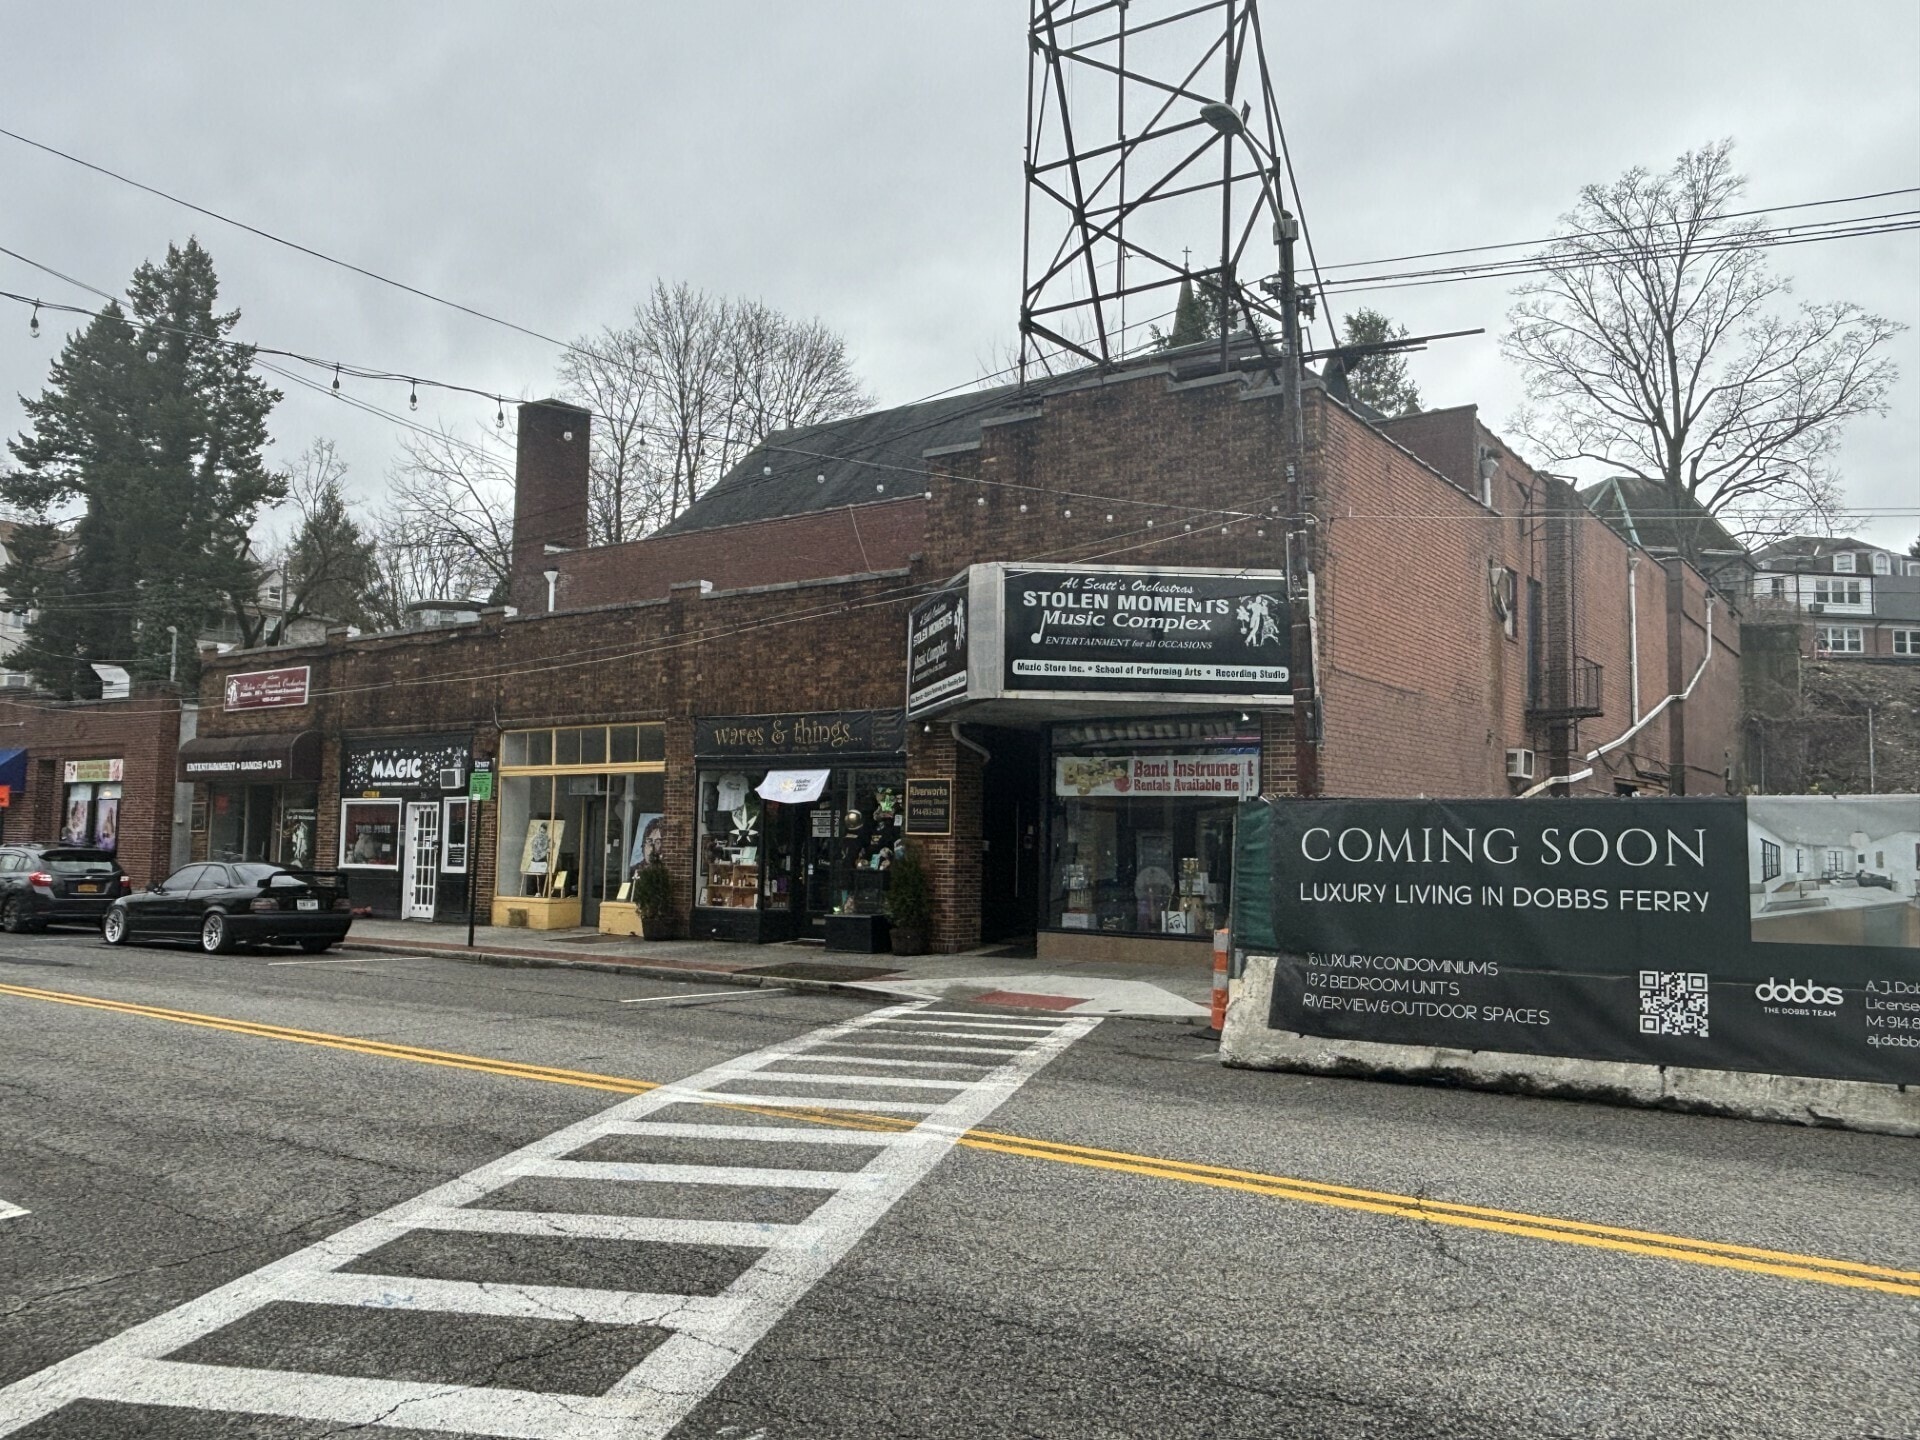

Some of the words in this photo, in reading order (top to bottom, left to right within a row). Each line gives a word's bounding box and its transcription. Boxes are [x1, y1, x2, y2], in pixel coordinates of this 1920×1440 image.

[1060, 577, 1079, 590] Al
[1082, 578, 1126, 591] Scatt's
[1132, 580, 1194, 593] Orchestras
[1023, 591, 1108, 609] STOLEN
[1118, 595, 1229, 614] MOMENTS
[1043, 610, 1105, 626] Music
[1113, 613, 1212, 632] Complex
[1045, 636, 1131, 647] ENTERTAINMENT
[1132, 639, 1144, 648] for
[1146, 639, 1156, 649] all
[1158, 639, 1213, 649] OCCASIONS
[1044, 663, 1066, 672] Store
[1069, 664, 1085, 673] Inc.
[1095, 664, 1123, 674] School
[1126, 665, 1134, 674] of
[1137, 666, 1182, 677] Performing
[1185, 667, 1202, 676] Arts
[1216, 668, 1257, 679] Recording
[1260, 669, 1286, 679] Studio
[715, 727, 764, 746] wares
[771, 719, 788, 745] &
[186, 762, 236, 772] ENTERTAINMENT
[240, 761, 262, 770] BANDS
[371, 758, 422, 779] MAGIC
[1134, 760, 1168, 777] Band
[1174, 759, 1254, 777] Instrumet
[910, 786, 948, 796] Riverworks
[1134, 778, 1171, 791] Rentals
[1174, 778, 1221, 791] Available
[1224, 778, 1253, 791] He!
[1301, 827, 1519, 865] COMING
[1541, 828, 1707, 867] SOON
[1300, 882, 1386, 903] LUXURY
[1396, 884, 1472, 905] LIVING
[1483, 886, 1503, 906] IN
[1514, 887, 1608, 909] DOBBS
[1620, 890, 1709, 913] FERRY
[1319, 953, 1372, 969] LUXURY
[1373, 956, 1498, 976] CONDOMINIUMS
[1330, 975, 1410, 993] BEDROOM
[1412, 980, 1460, 996] UNITS
[1755, 977, 1844, 1005] dobbs
[1391, 1000, 1477, 1020] OUTDOOR
[1482, 1006, 1550, 1025] SPACES
[1764, 1006, 1779, 1014] THE
[1782, 1008, 1810, 1016] DOBBS
[1812, 1009, 1836, 1017] TEAM
